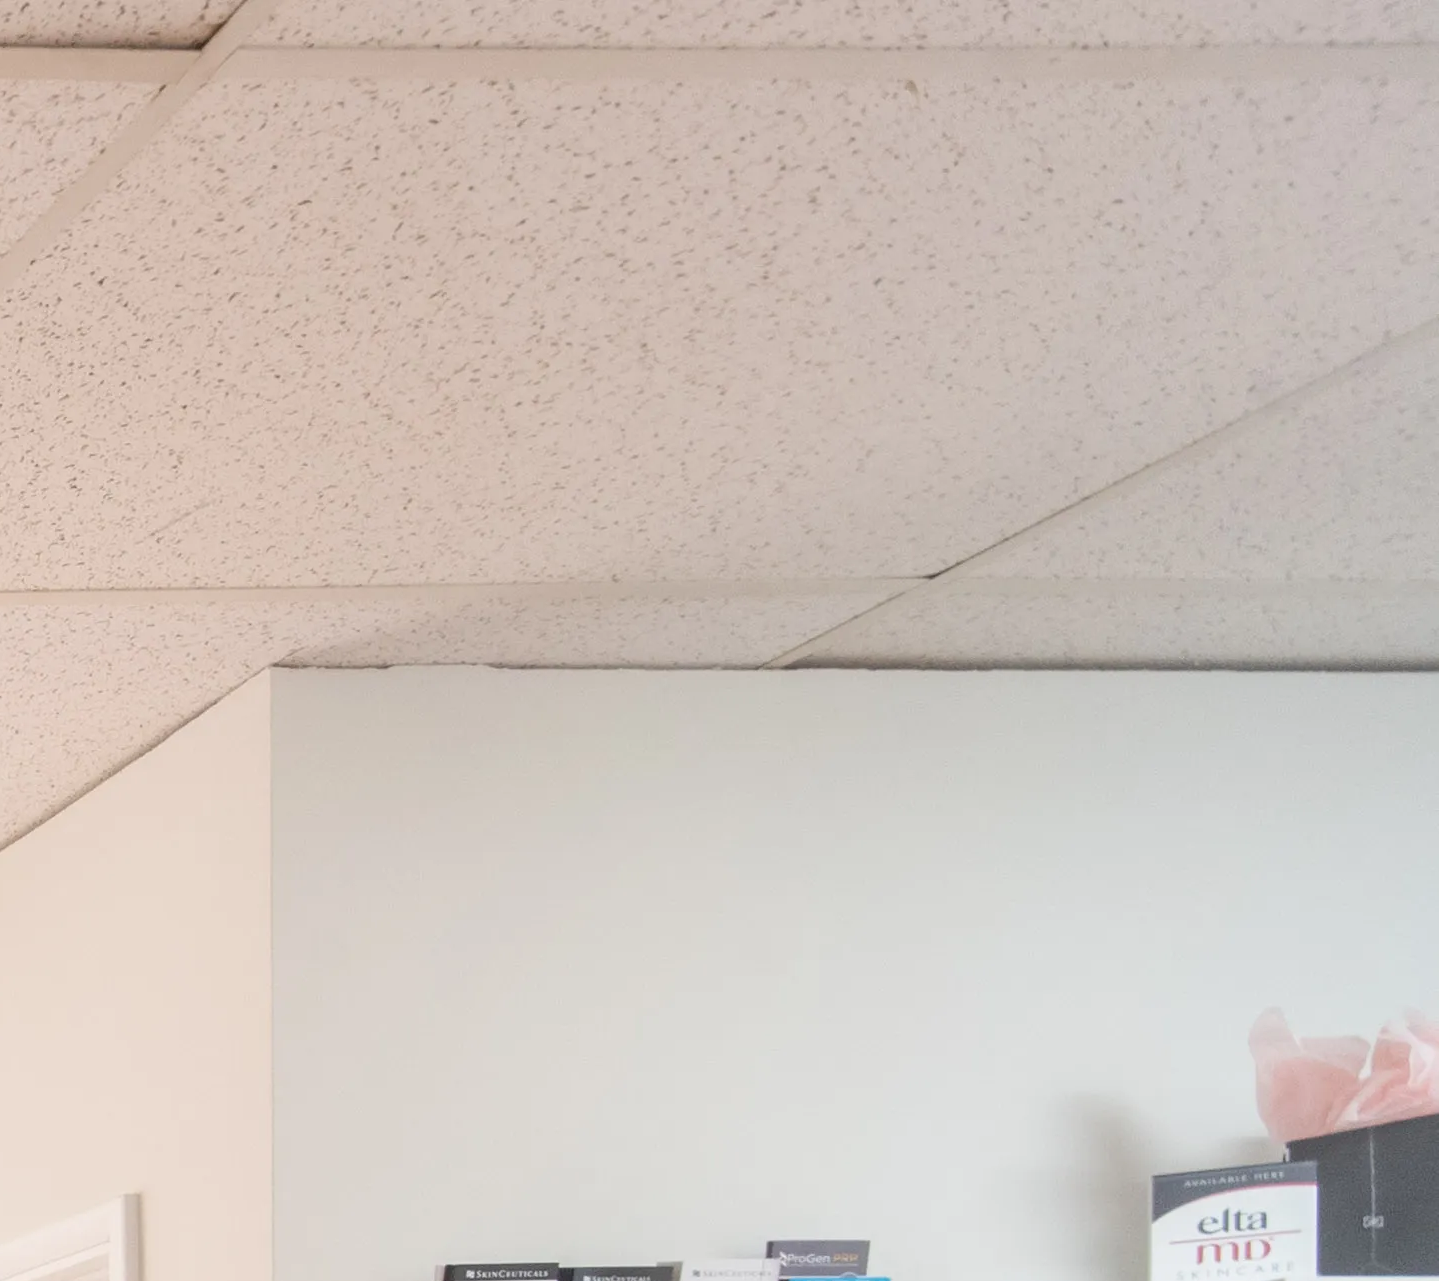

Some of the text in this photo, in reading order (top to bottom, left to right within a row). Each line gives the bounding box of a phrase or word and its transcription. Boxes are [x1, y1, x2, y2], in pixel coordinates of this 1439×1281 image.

[1184, 1171, 1286, 1188] AVAILABLE HERE
[1198, 1208, 1268, 1235] elta
[788, 1253, 830, 1264] ProGen
[476, 1269, 549, 1279] SKINCEUTICALS
[1177, 1262, 1296, 1281] SKINCARE
